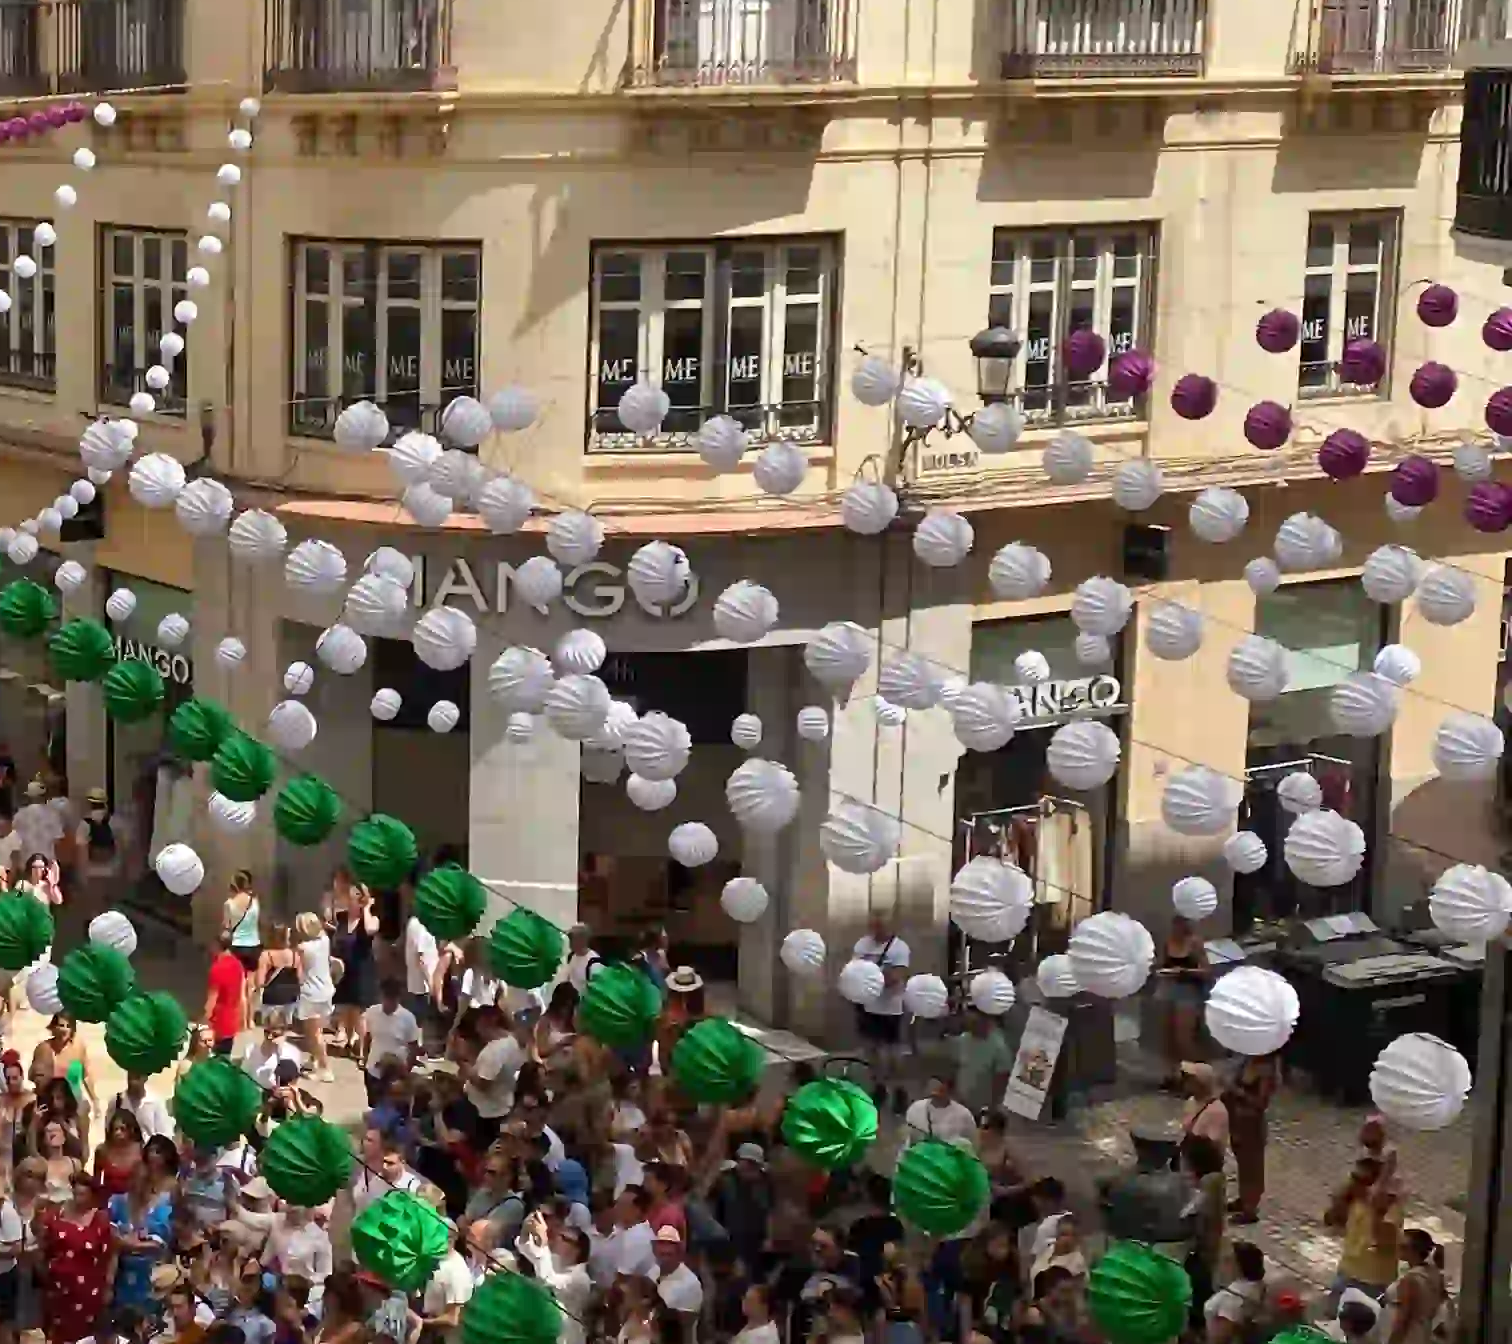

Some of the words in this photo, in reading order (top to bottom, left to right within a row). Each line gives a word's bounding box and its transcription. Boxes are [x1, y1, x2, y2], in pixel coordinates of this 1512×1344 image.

[390, 355, 417, 377] ME
[444, 357, 473, 379] ME
[664, 357, 698, 381] ME
[731, 354, 759, 379] ME
[783, 352, 814, 375] ME
[1008, 674, 1121, 717] ANGO
